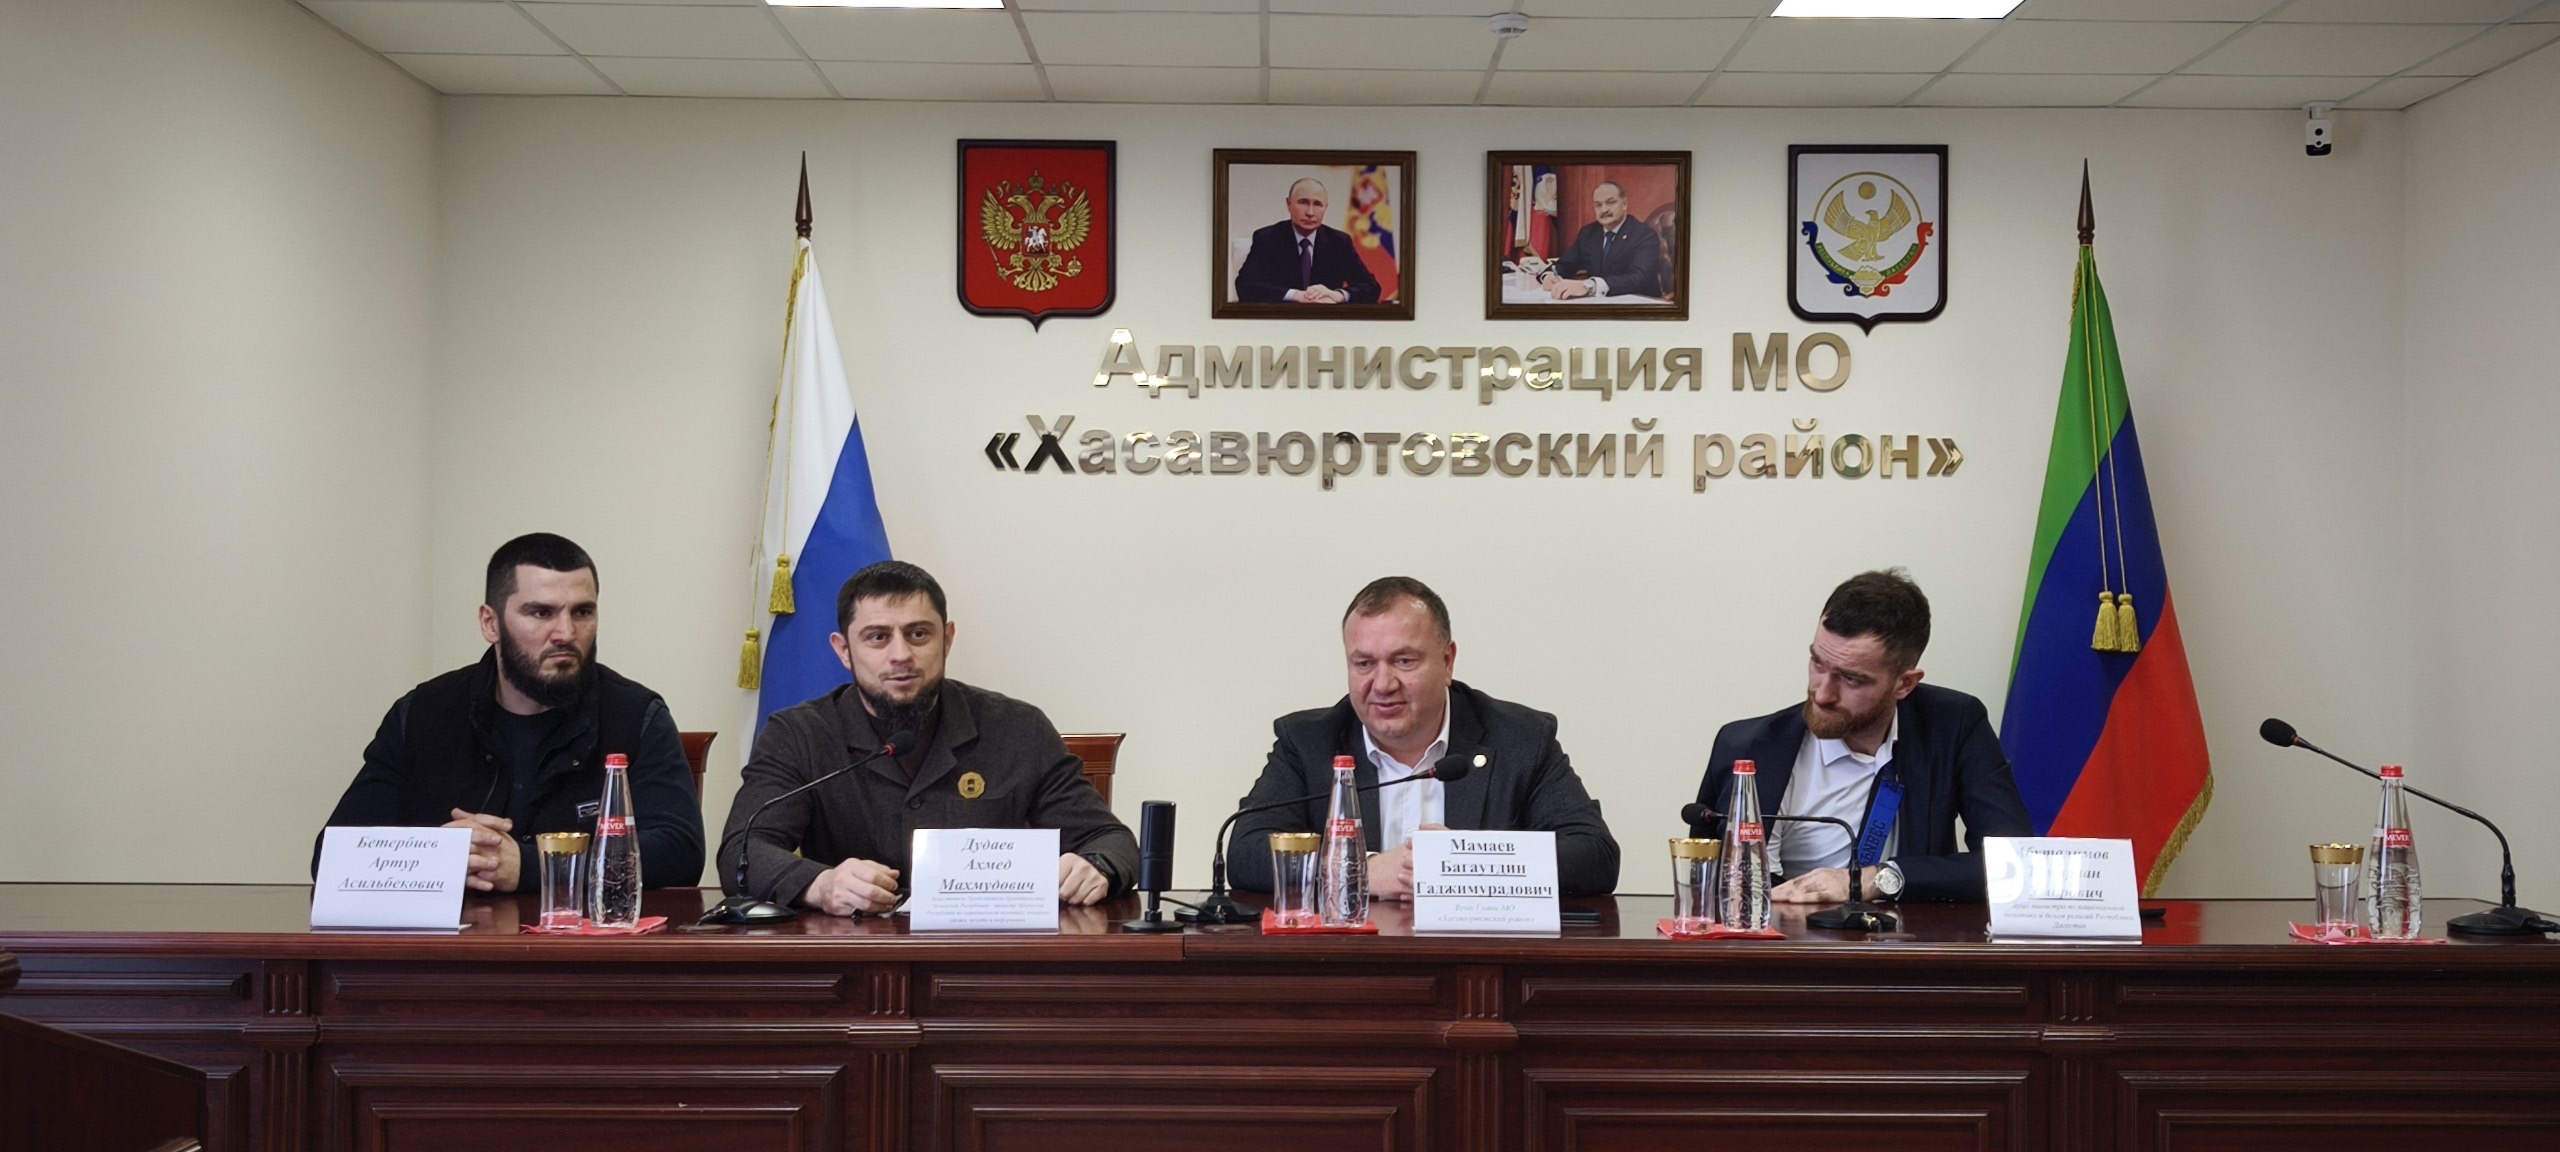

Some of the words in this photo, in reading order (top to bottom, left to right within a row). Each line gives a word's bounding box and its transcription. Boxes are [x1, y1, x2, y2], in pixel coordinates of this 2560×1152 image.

[1093, 328, 1702, 405] Администрация
[1732, 331, 1852, 392] МО
[984, 414, 1665, 490] «Хасавюртовский
[1693, 418, 1964, 493] район»
[357, 836, 439, 851] Бетербиев
[961, 838, 1015, 854] Дудаев
[1450, 838, 1515, 853] Мамаев
[369, 857, 420, 872] Артур
[963, 859, 1012, 871] Ахмед
[1441, 860, 1526, 875] Багаутдин
[338, 877, 445, 890] Асильбекович
[940, 879, 1035, 892] Махмудович
[1416, 882, 1552, 897] Гаджимурадович
